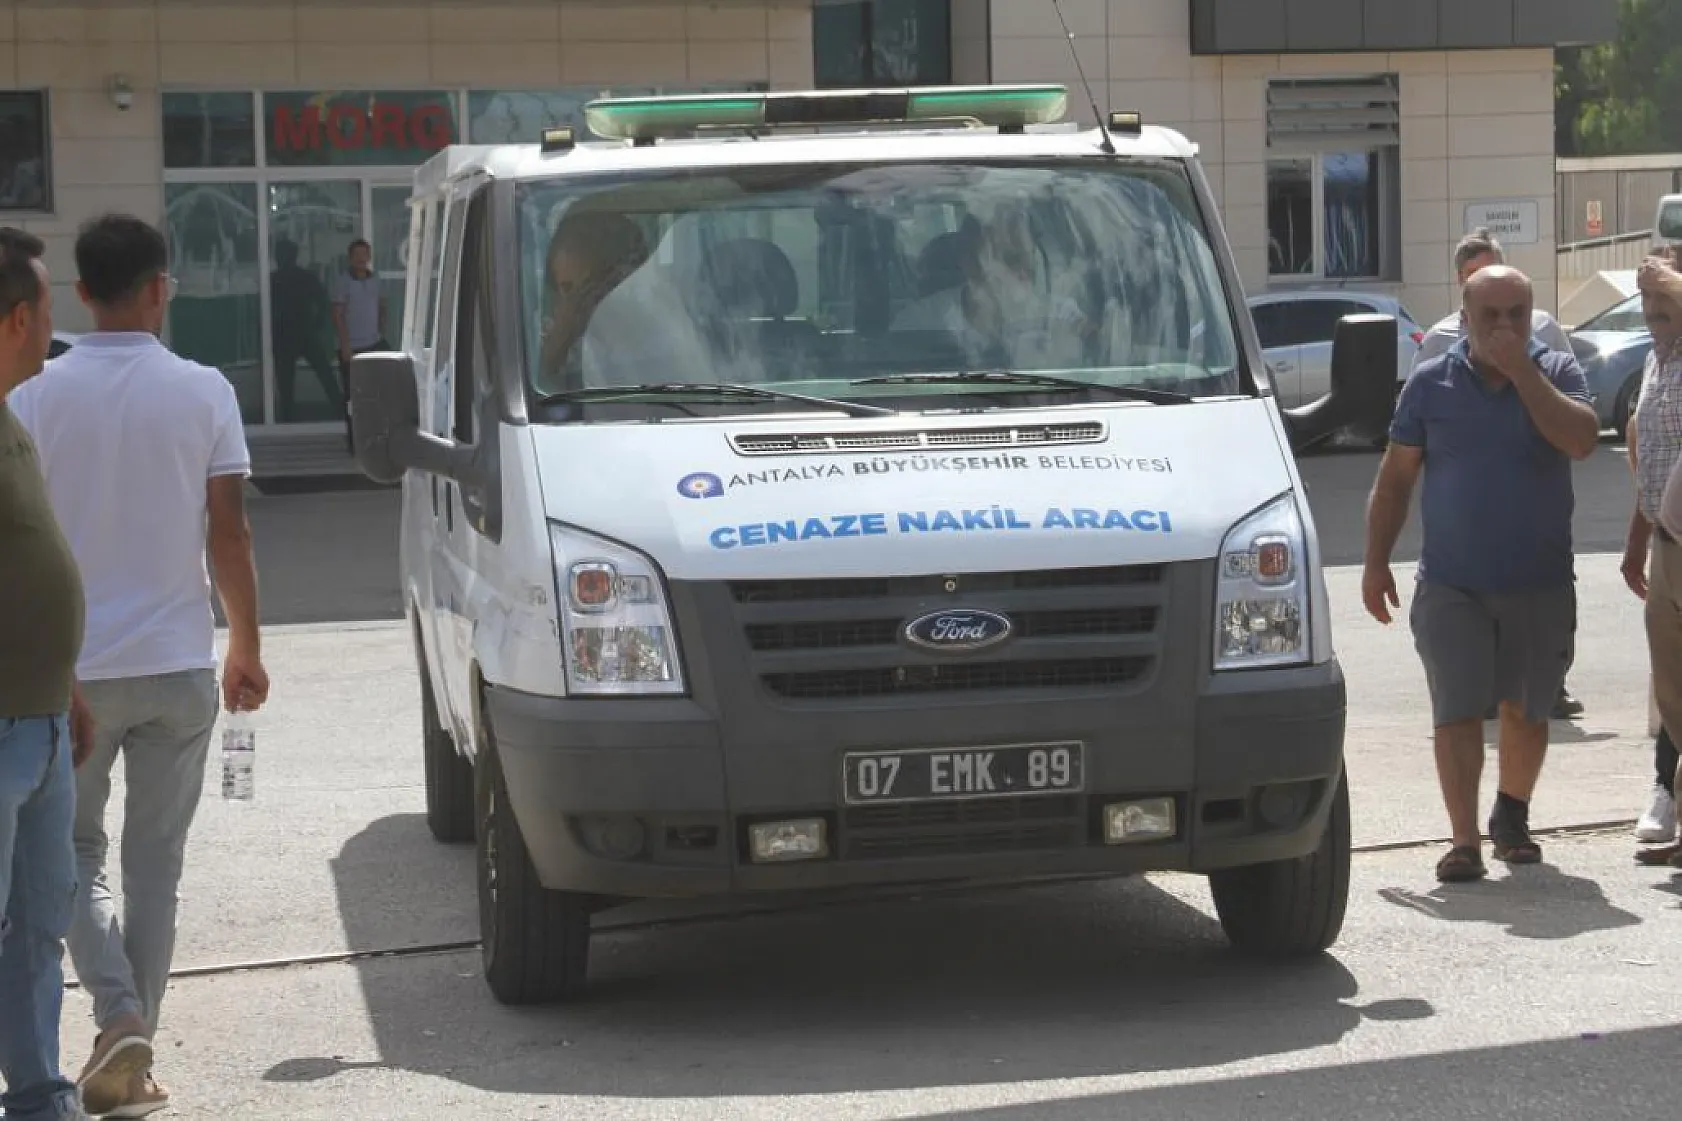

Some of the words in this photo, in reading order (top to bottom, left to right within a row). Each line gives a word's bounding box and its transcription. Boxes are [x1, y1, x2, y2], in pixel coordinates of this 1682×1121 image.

[275, 105, 454, 150] MORG
[728, 463, 844, 488] ANTALYA
[853, 452, 1029, 475] BÜYÜKŞEHİR
[1038, 454, 1172, 473] BELEDİYESİ
[709, 513, 887, 549] CENAZE
[897, 505, 1031, 532] NAKİL
[1042, 508, 1172, 533] ARACI
[931, 616, 987, 640] Ford
[857, 757, 901, 796] 07
[930, 752, 996, 793] EMK
[1028, 749, 1070, 788] 89
